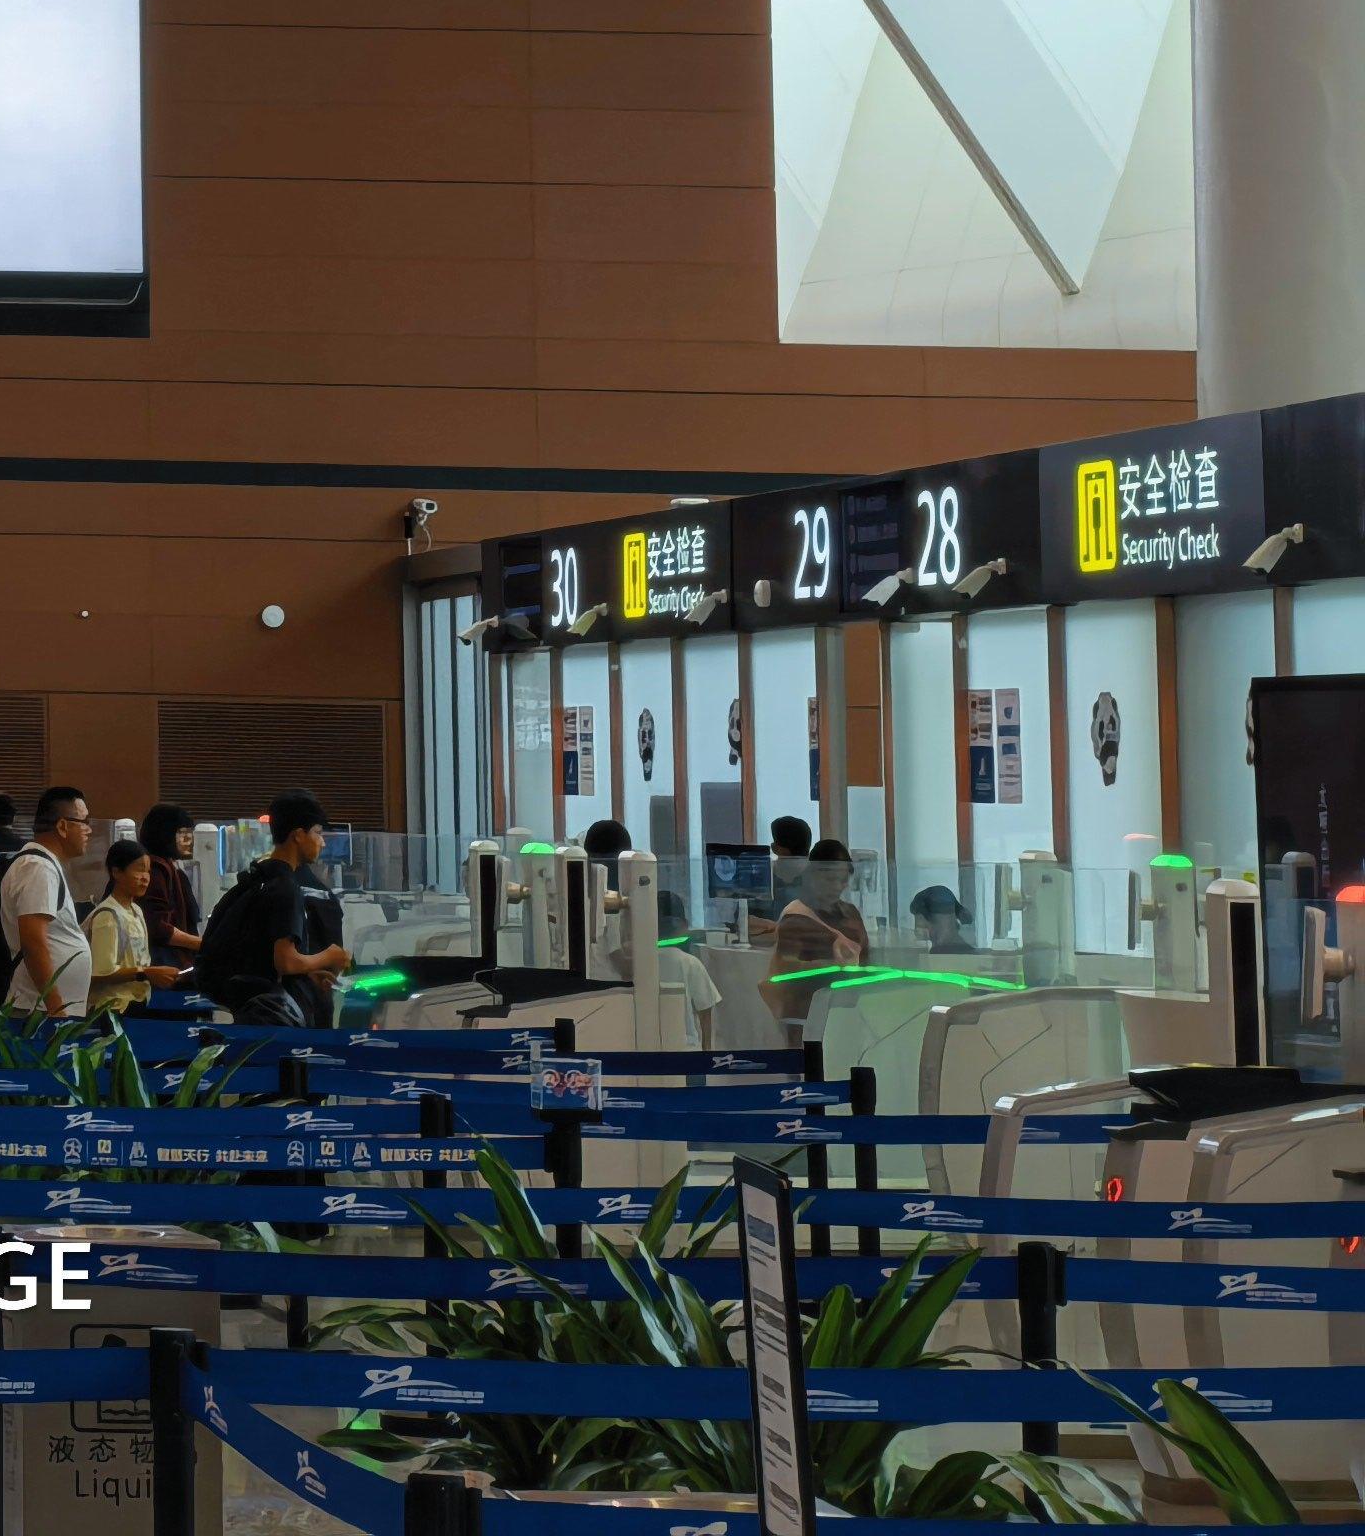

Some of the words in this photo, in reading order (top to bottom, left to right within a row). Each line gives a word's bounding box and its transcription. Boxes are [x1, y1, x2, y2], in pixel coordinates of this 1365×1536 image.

[1118, 445, 1220, 520] 安全检查
[647, 525, 706, 580] 安全检查
[794, 506, 830, 600] 29
[917, 486, 961, 587] 28
[1122, 528, 1176, 570] Security
[1178, 522, 1221, 562] Check
[550, 547, 579, 628] 30
[648, 586, 680, 619] Security
[75, 1468, 152, 1507] Liqui
